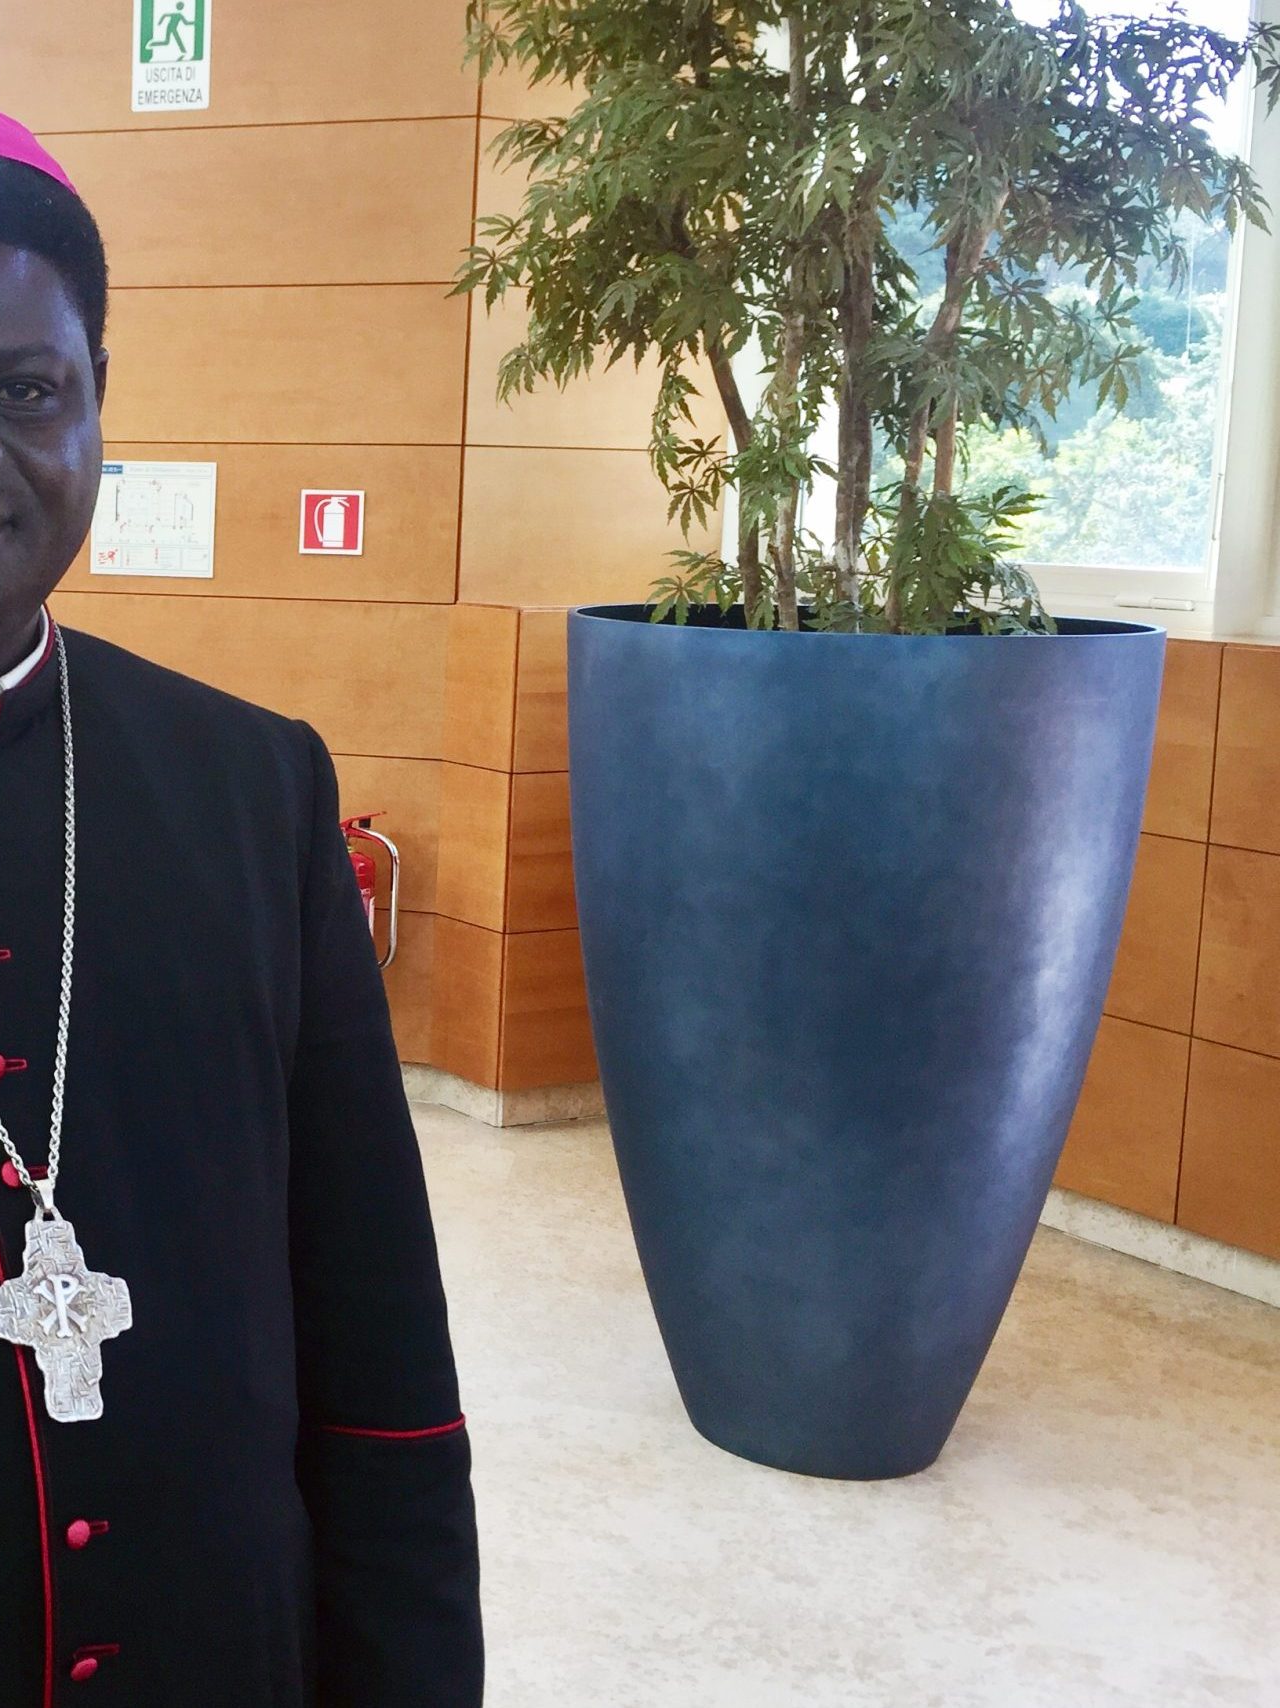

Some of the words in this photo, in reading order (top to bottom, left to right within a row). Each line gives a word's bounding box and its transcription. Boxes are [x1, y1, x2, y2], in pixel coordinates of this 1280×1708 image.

[145, 66, 182, 83] USCITA
[185, 66, 196, 81] DI
[137, 88, 203, 105] EMERGENZA
